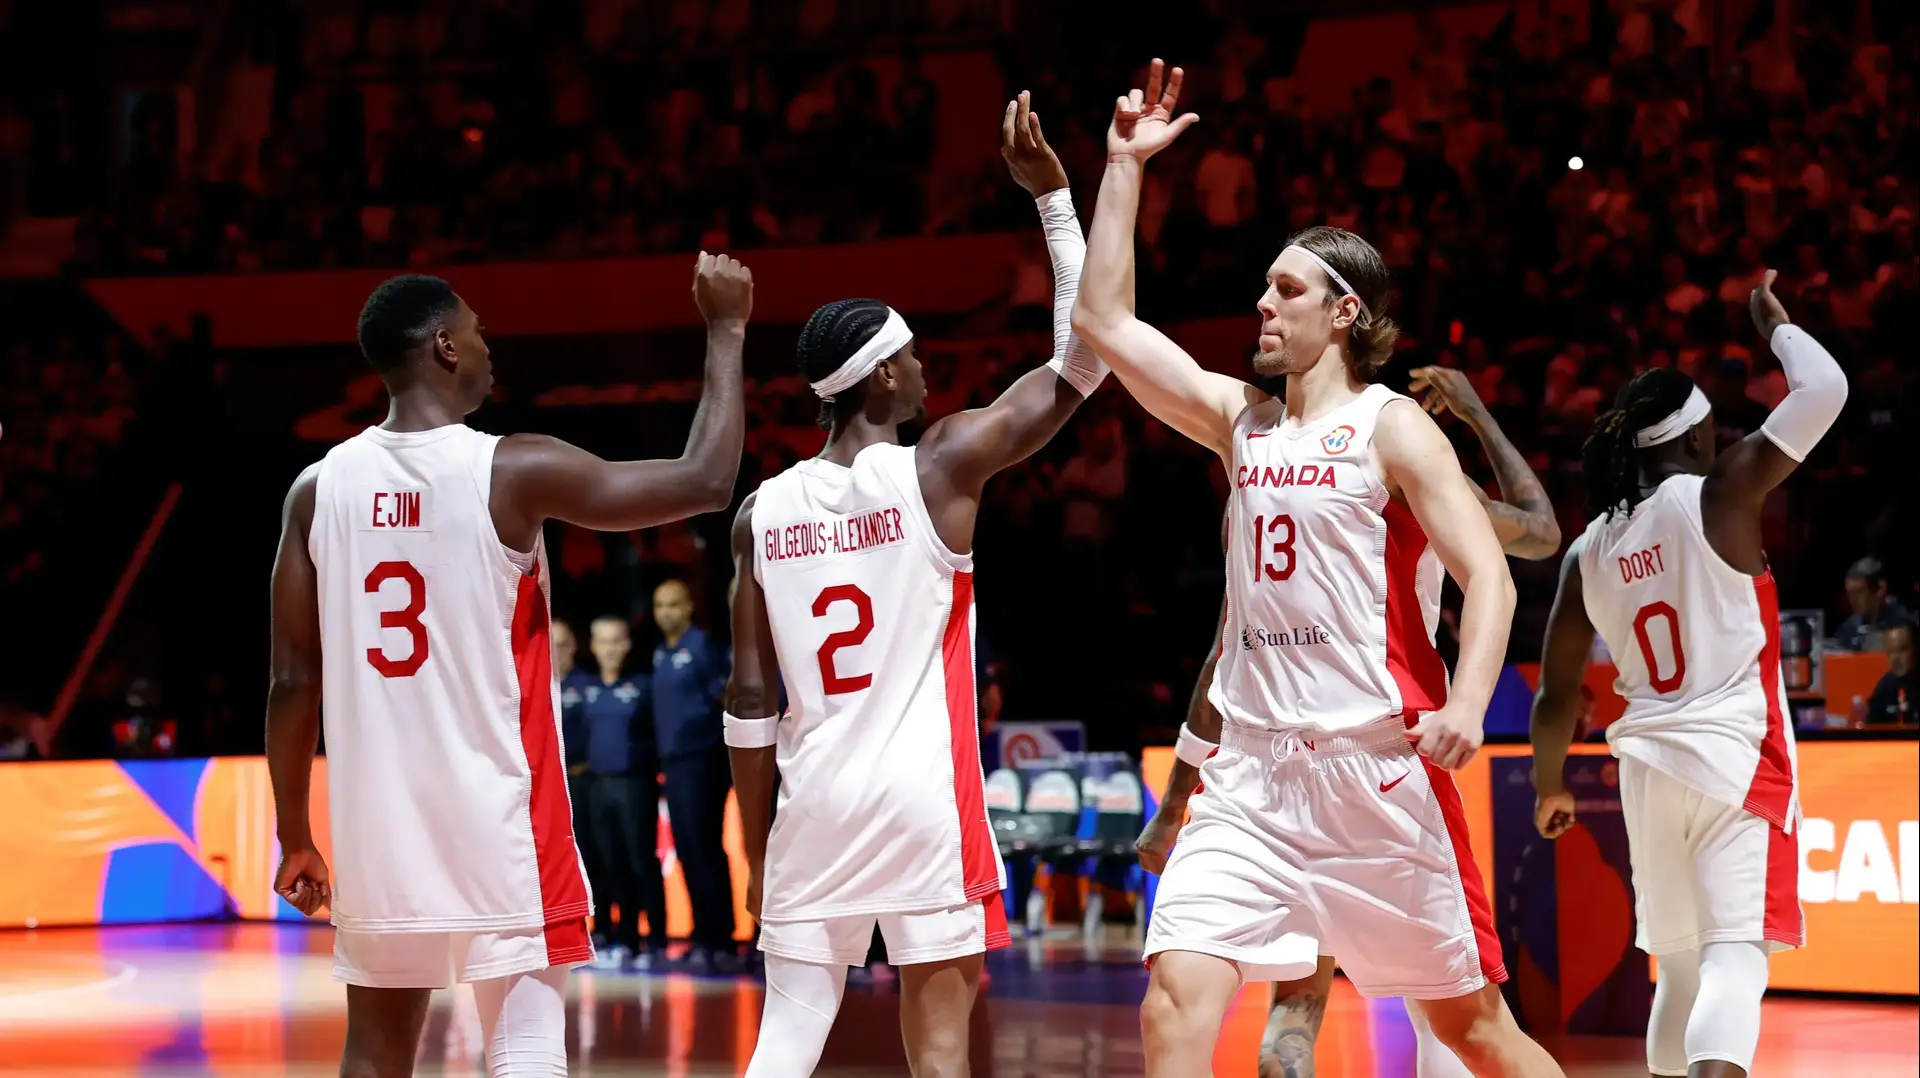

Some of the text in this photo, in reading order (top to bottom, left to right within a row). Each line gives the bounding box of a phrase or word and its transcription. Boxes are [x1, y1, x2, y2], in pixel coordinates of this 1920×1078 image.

[1237, 465, 1337, 489] CANADA
[372, 491, 421, 528] EJIM
[765, 507, 905, 562] GILGEOUS-ALEXANDER
[1254, 513, 1297, 583] 13
[1617, 543, 1665, 584] DORT
[364, 560, 430, 678] 3
[811, 583, 875, 696] 2
[1257, 625, 1330, 647] Sun Life
